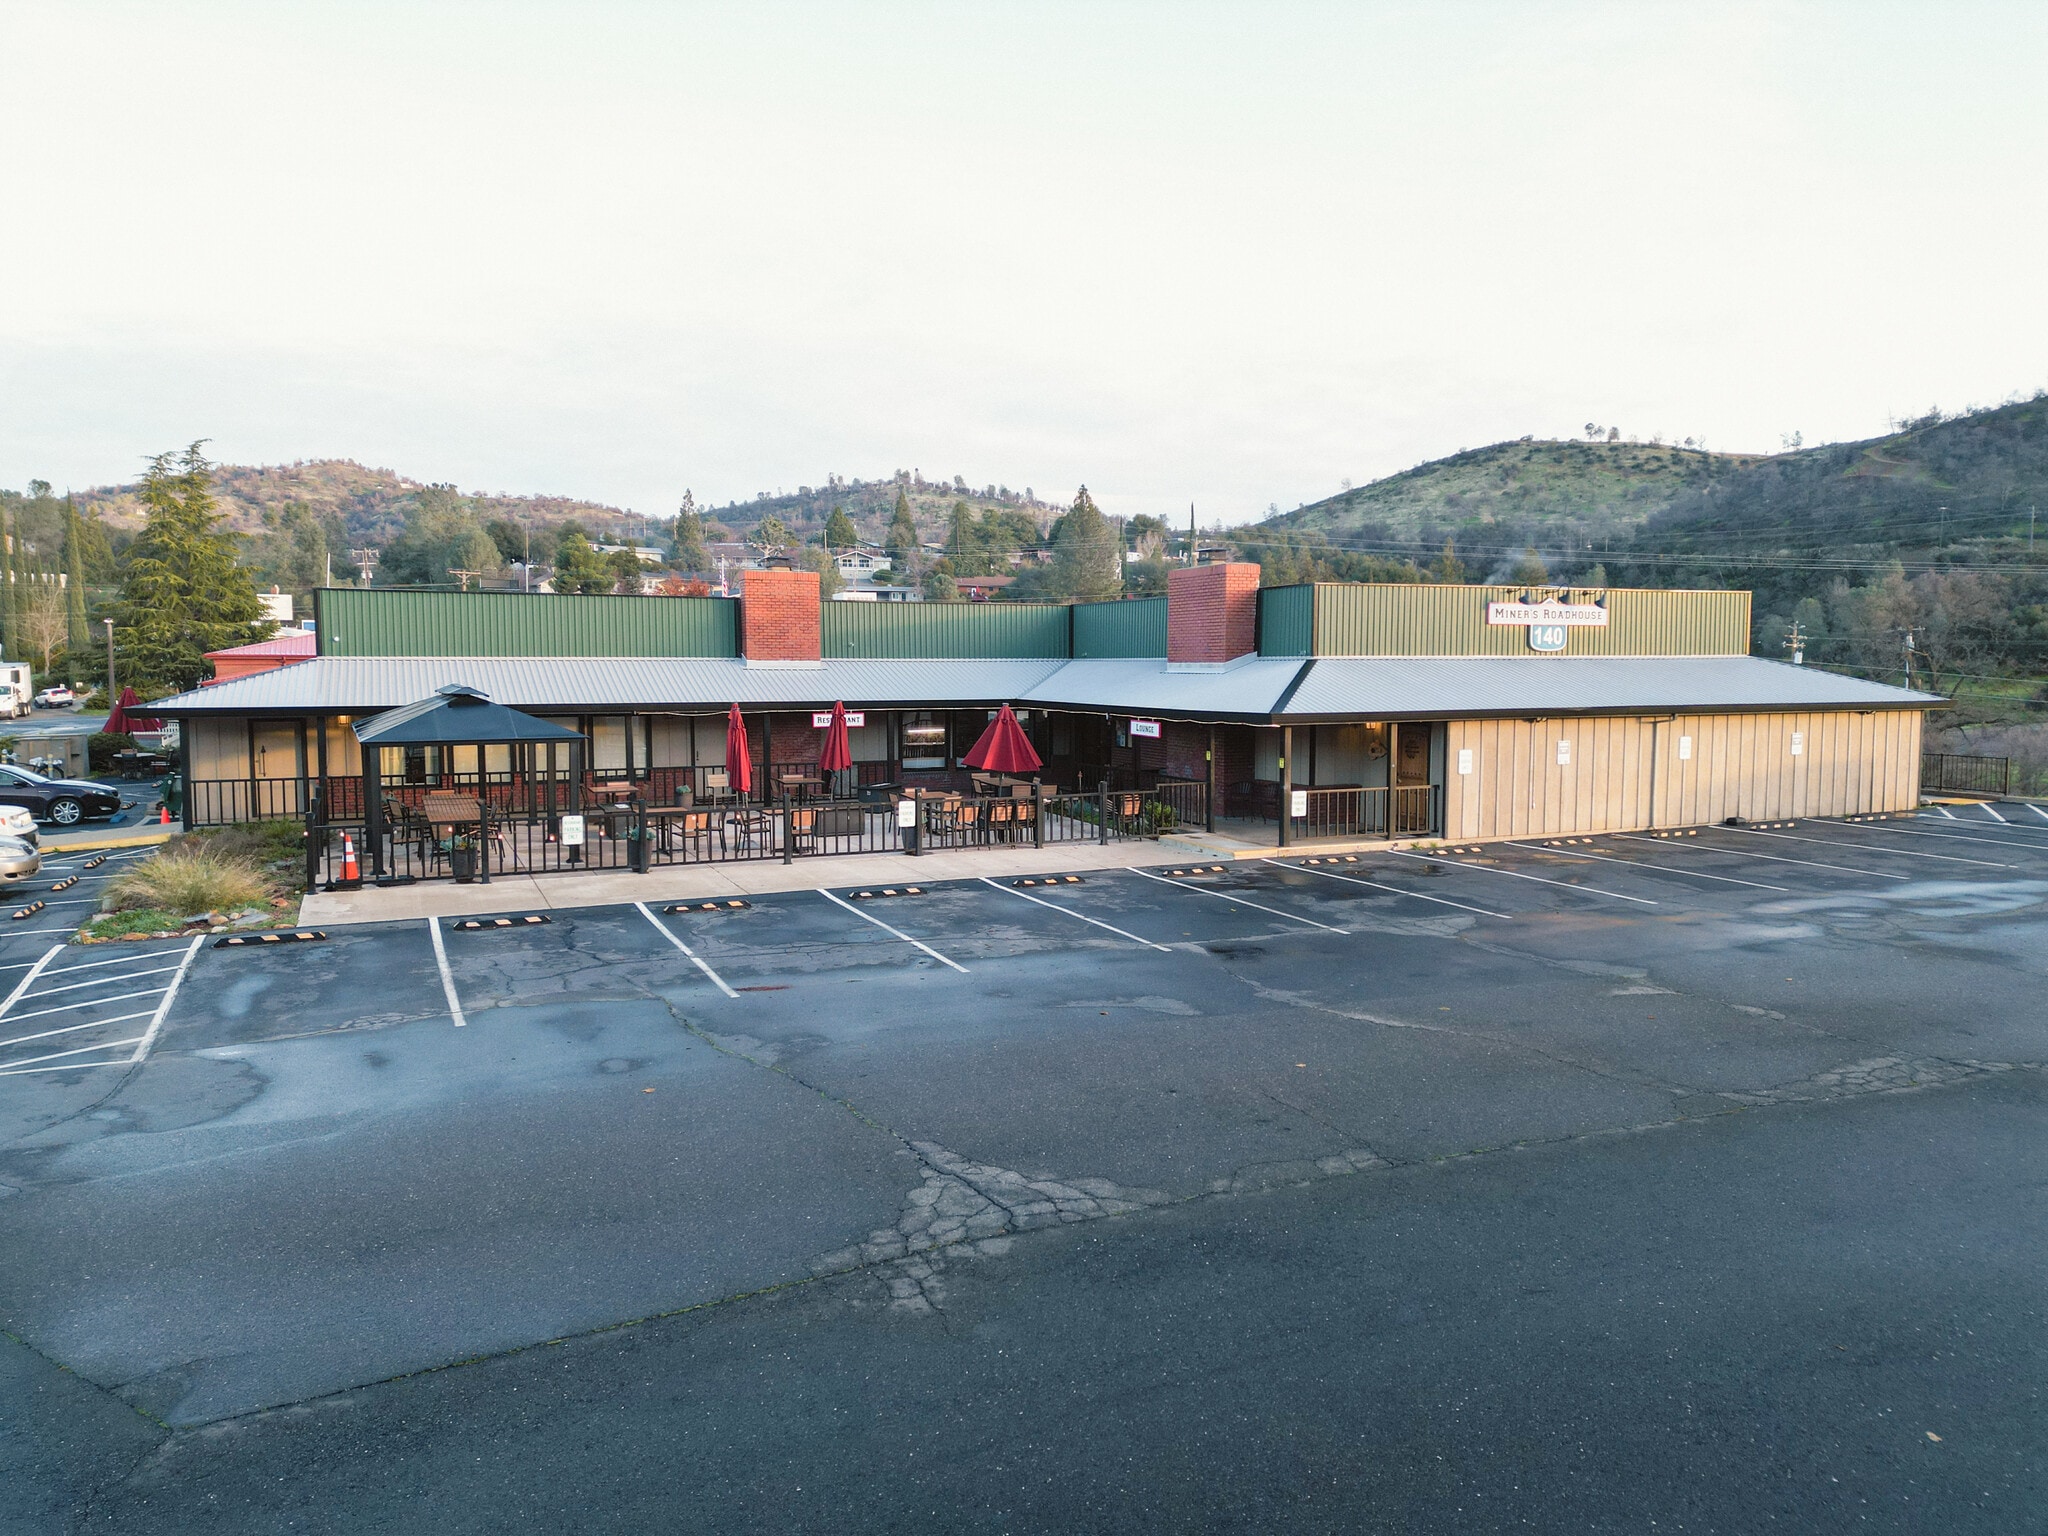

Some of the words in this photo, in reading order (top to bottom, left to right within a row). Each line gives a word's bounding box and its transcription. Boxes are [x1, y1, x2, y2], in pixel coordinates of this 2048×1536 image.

[1495, 608, 1539, 619] MINER'S
[1543, 609, 1602, 620] ROADHOUSE
[1534, 626, 1563, 645] 140
[817, 716, 860, 724] RESANT
